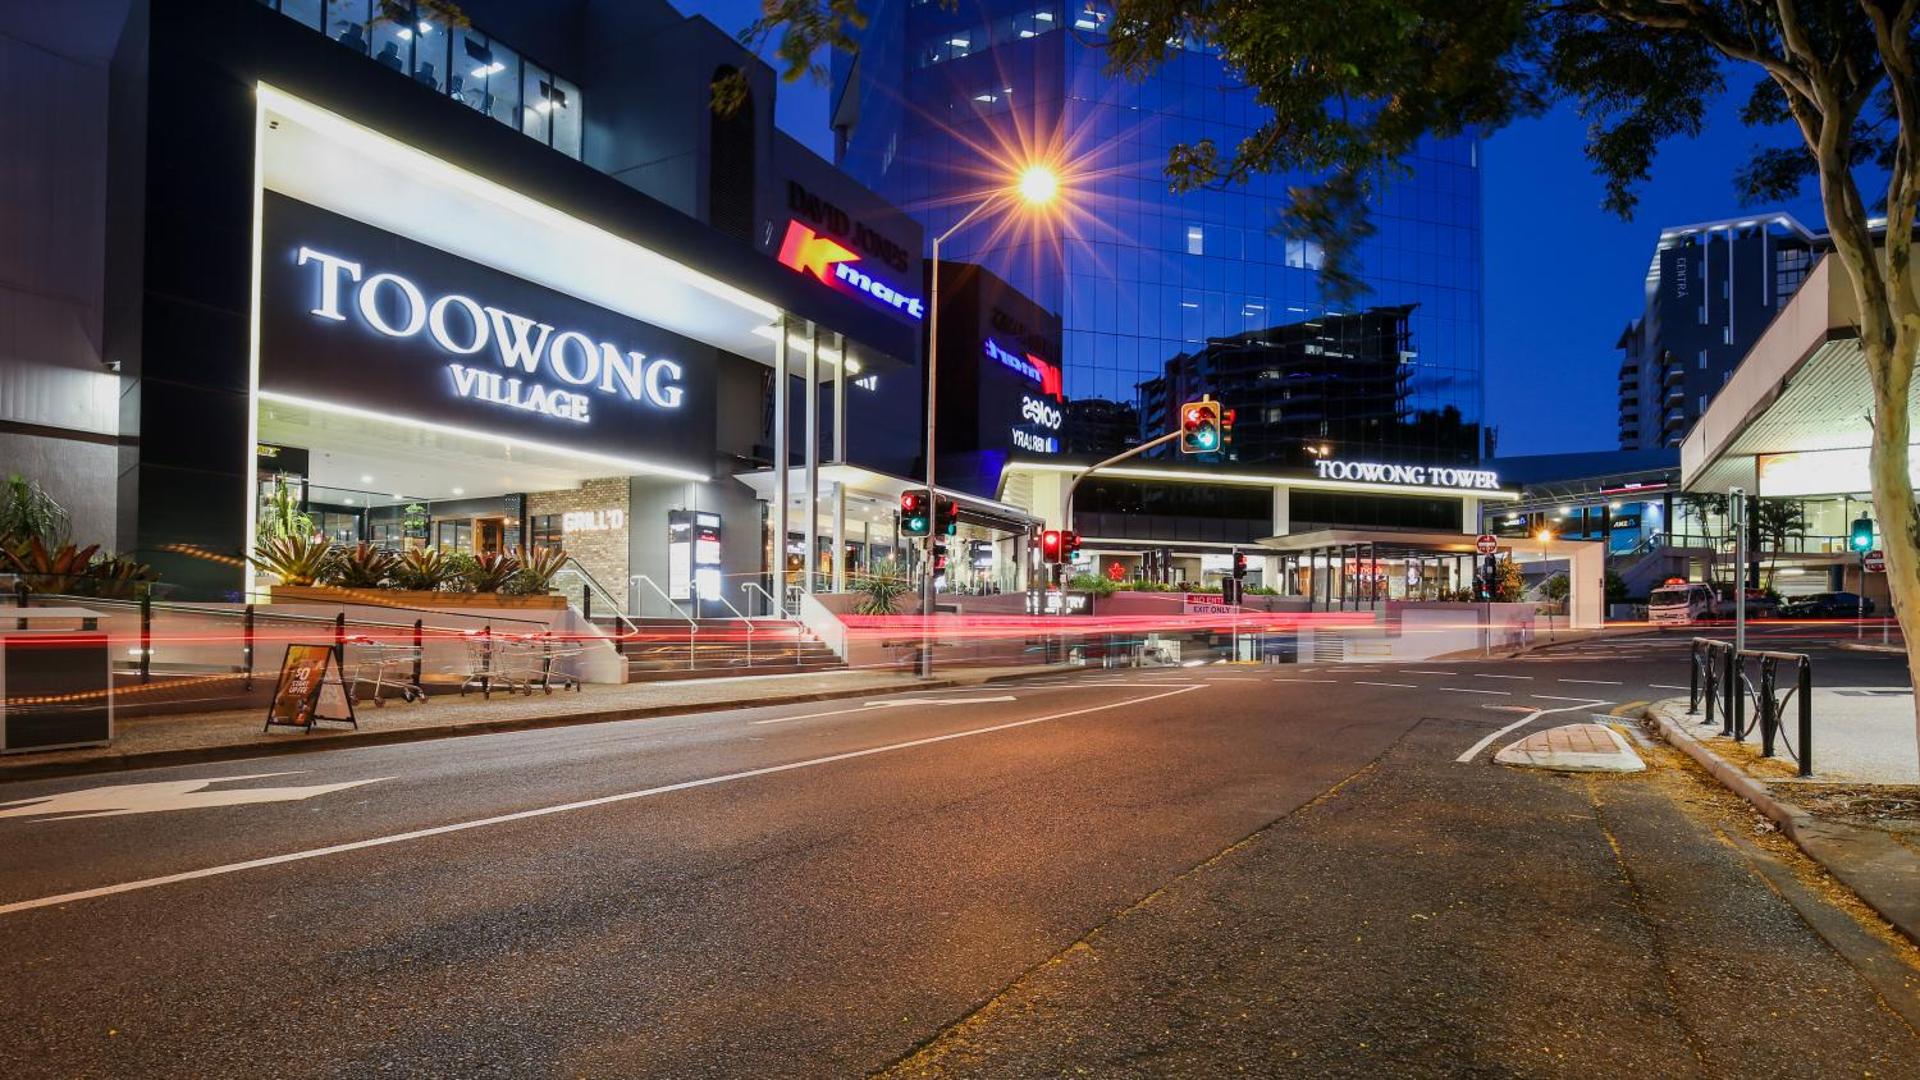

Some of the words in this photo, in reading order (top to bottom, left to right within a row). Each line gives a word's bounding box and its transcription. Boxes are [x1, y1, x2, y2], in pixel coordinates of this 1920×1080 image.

[787, 179, 850, 237] DAVID
[852, 221, 909, 274] JONES
[297, 246, 685, 410] TOOWONG
[449, 363, 591, 424] VILLAGE
[1315, 459, 1425, 484] TOOWONG
[1428, 467, 1500, 489] TOWER
